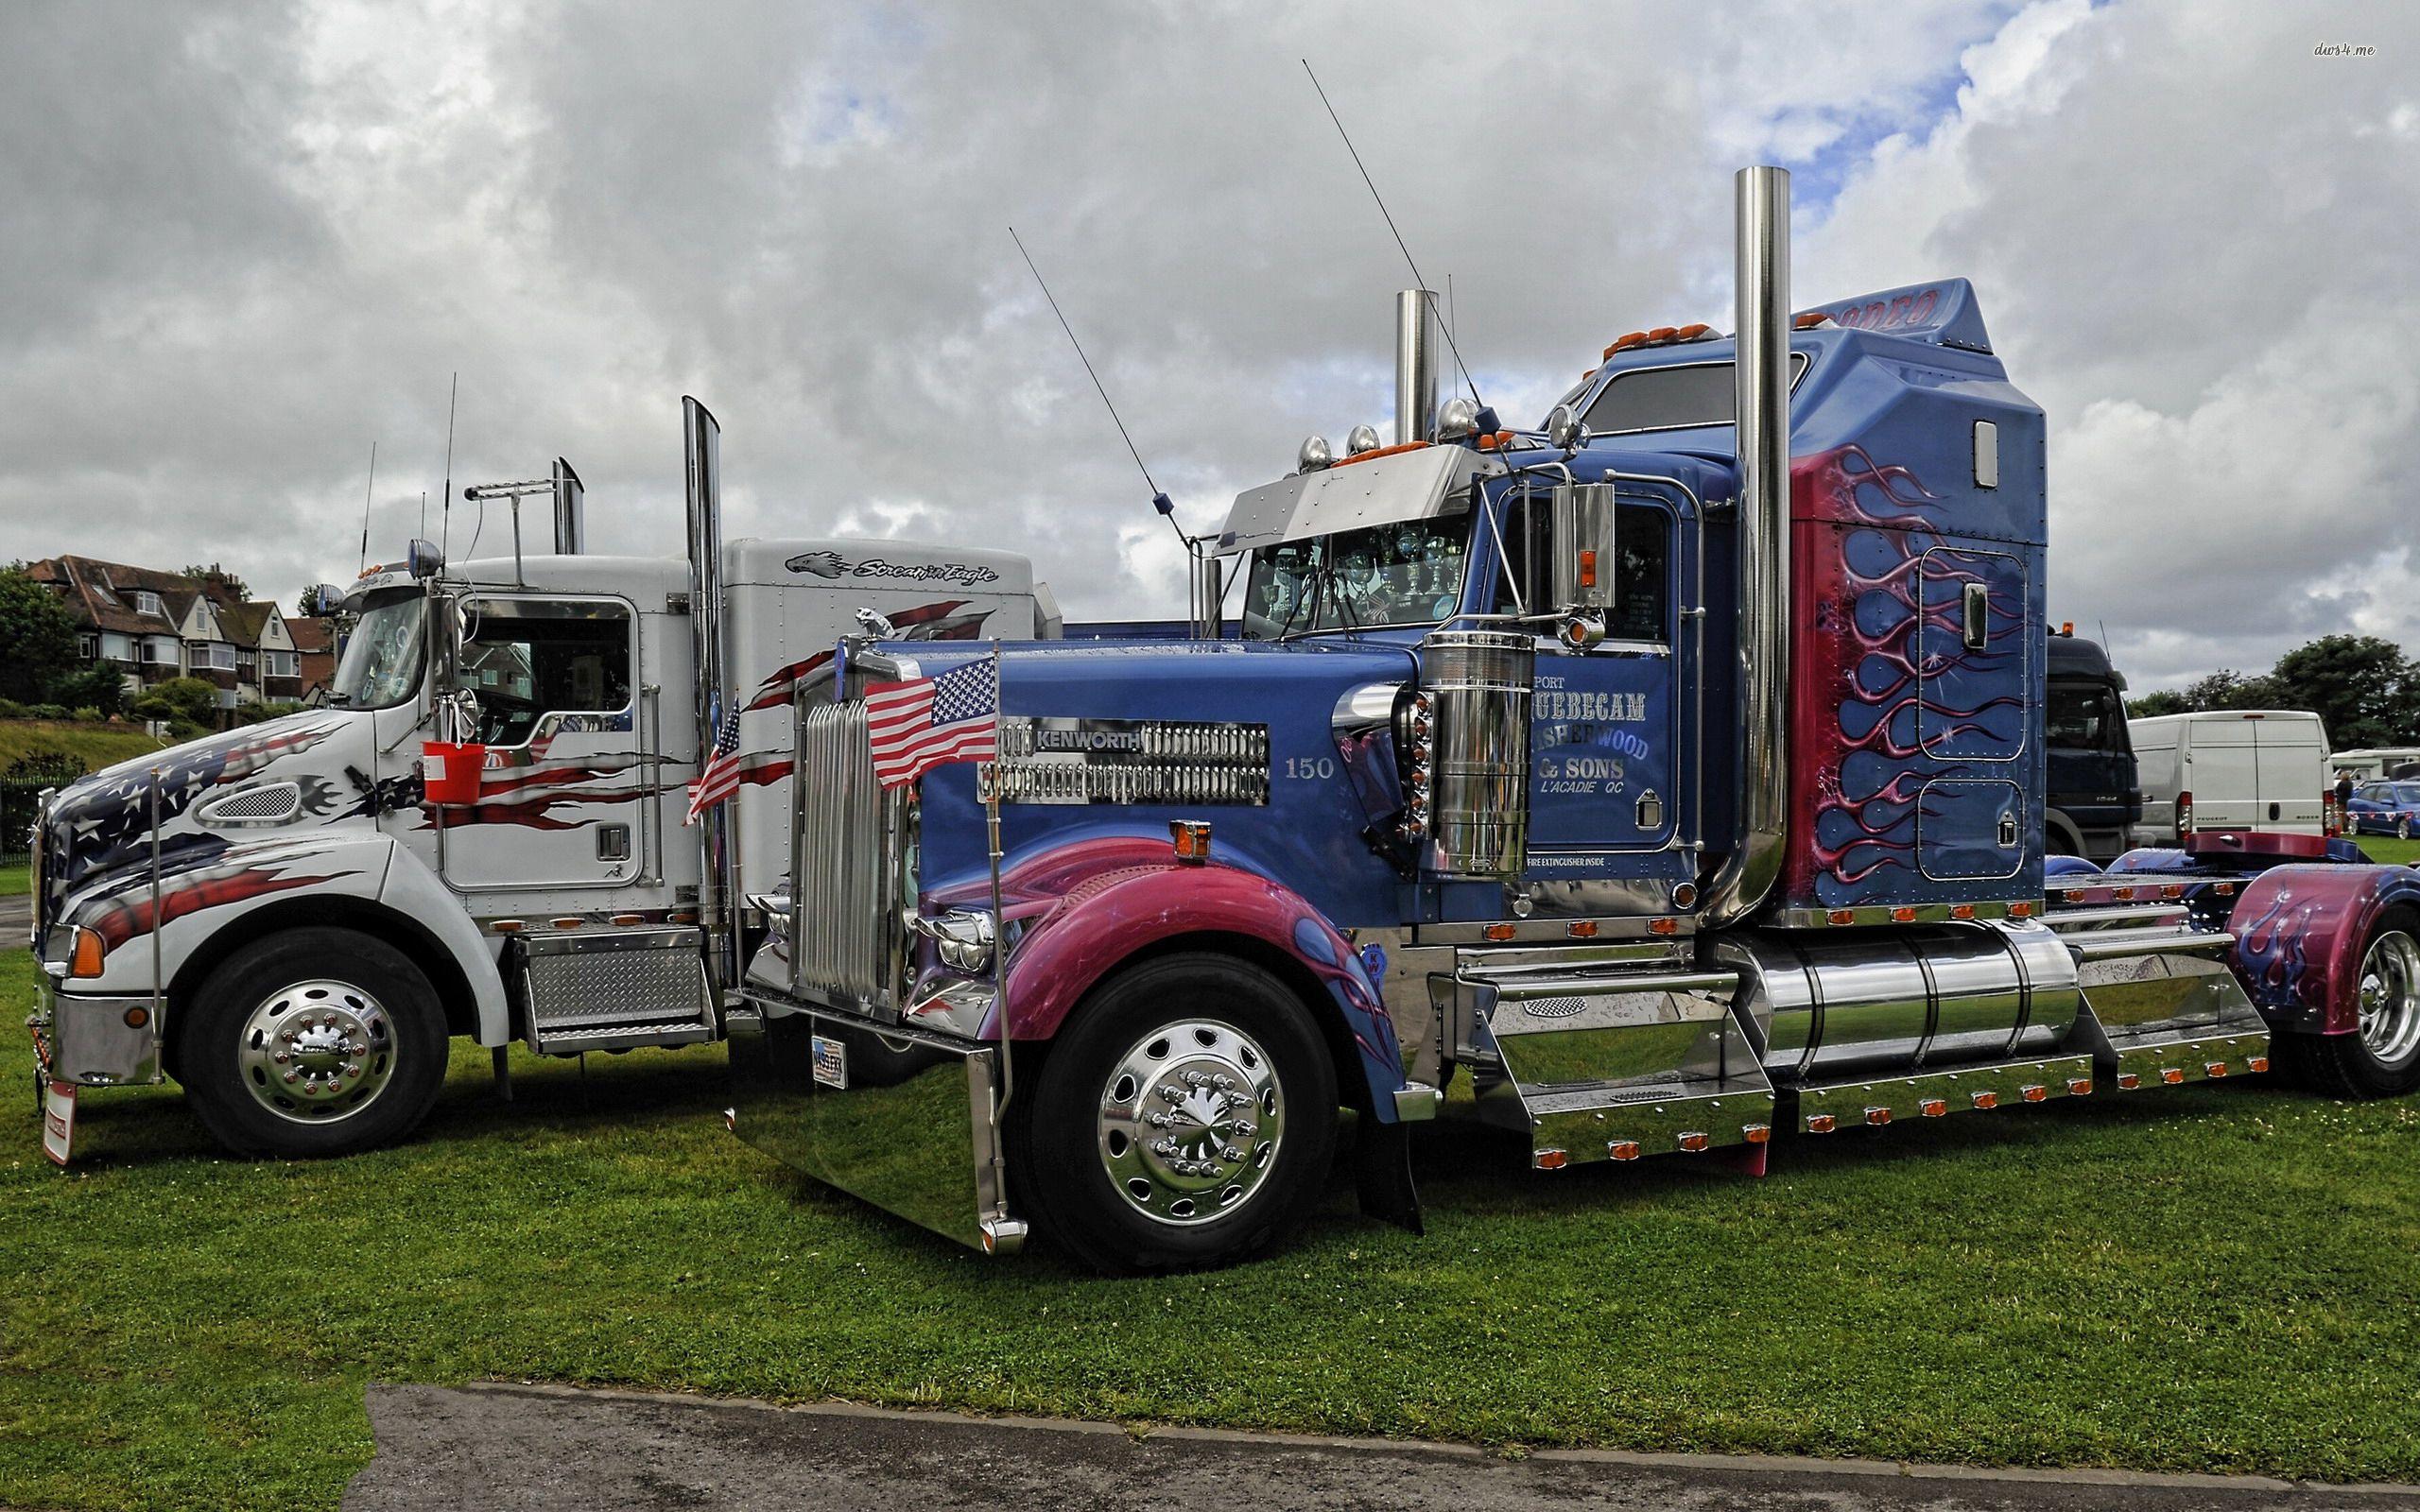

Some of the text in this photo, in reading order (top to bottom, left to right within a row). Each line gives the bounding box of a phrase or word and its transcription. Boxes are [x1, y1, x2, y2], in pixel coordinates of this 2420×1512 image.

[1828, 289, 1938, 331] ODEO
[943, 564, 999, 587] Eagle
[1531, 691, 1646, 721] UEBECAM
[1037, 730, 1140, 748] KENWORTH
[1286, 757, 1334, 780] 150
[1539, 758, 1624, 780] & SONS
[1541, 781, 1624, 794] L'ACADIE QC
[1527, 857, 1604, 867] FIRE EXTINGUISHER INSIDE
